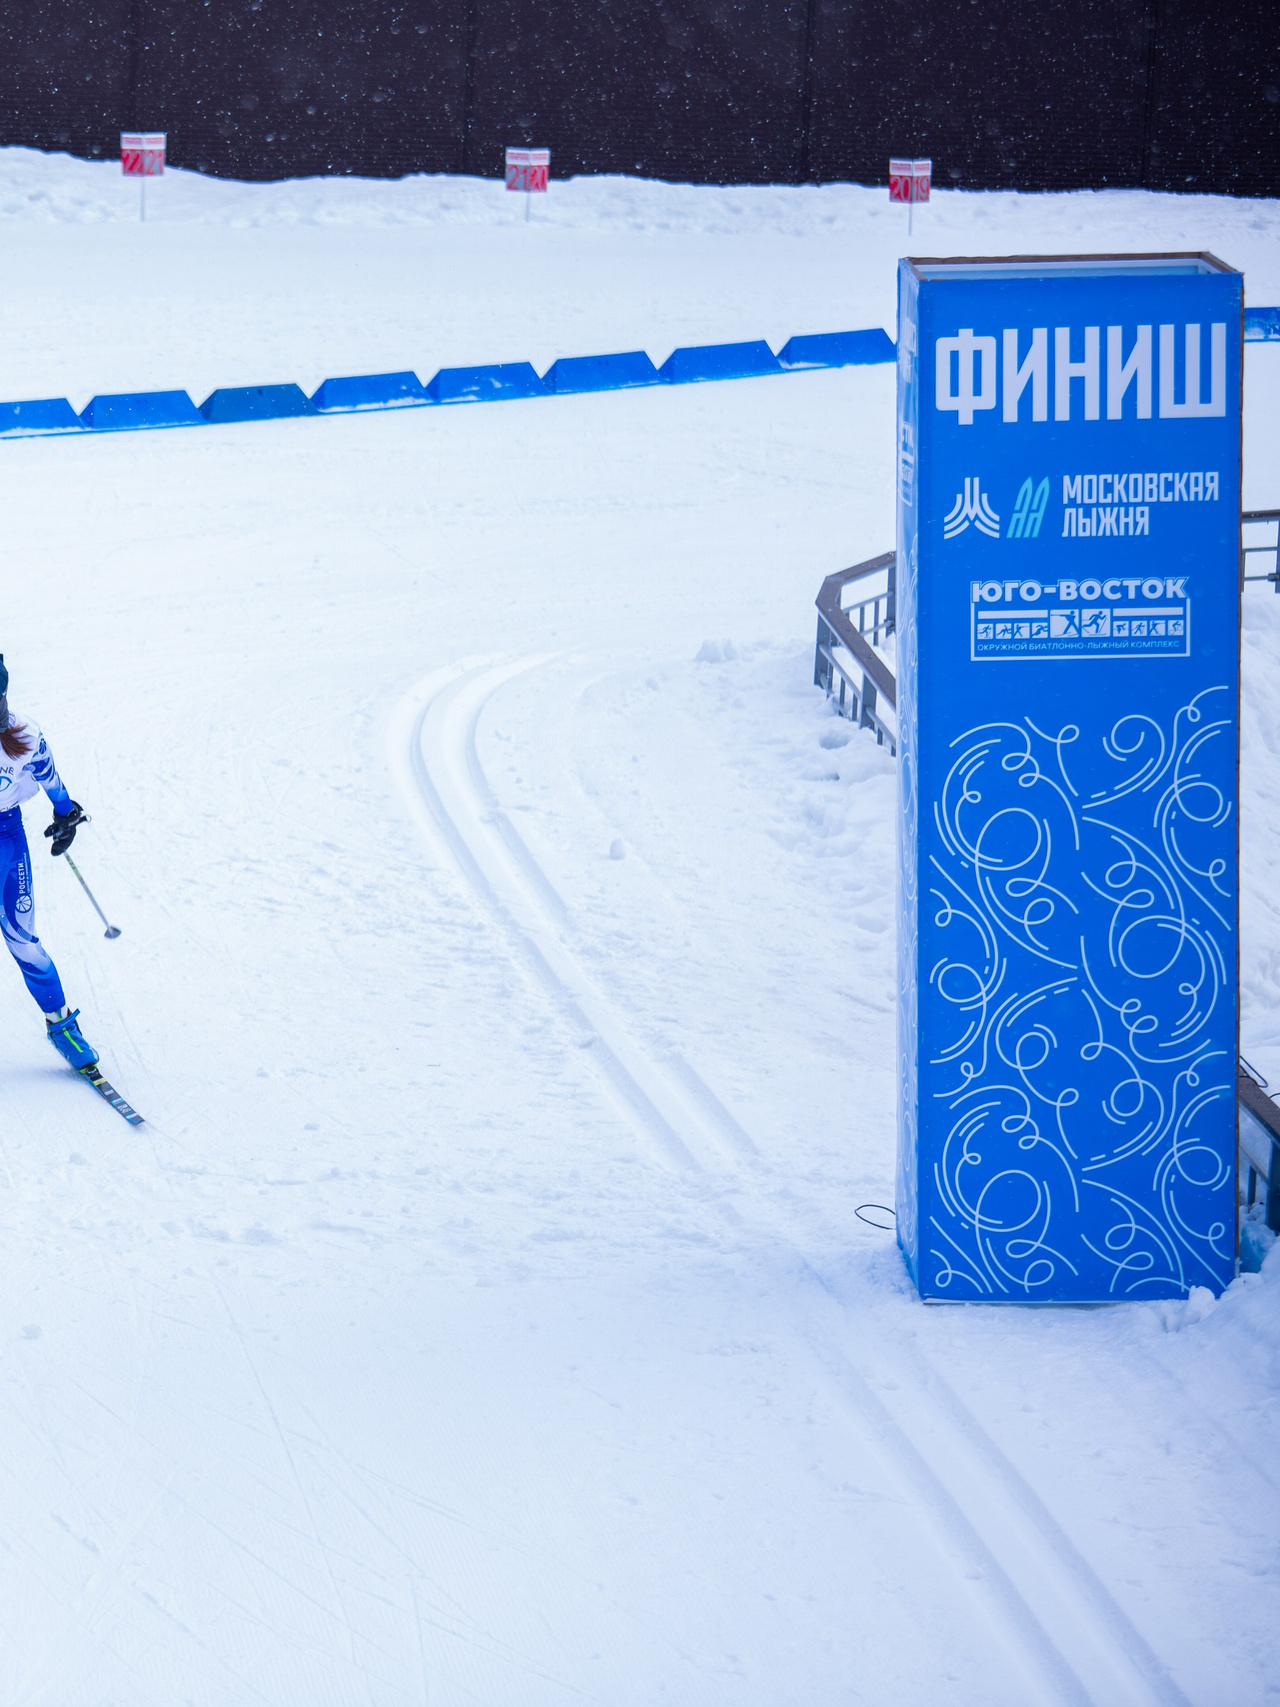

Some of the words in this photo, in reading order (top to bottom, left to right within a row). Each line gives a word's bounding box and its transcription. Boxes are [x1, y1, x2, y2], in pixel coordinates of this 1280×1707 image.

[507, 165, 528, 190] 21
[890, 175, 912, 202] 20
[913, 176, 930, 202] 19
[935, 322, 1227, 426] ФИНИШ
[1062, 471, 1219, 505] МОСКОВСКАЯ
[1061, 506, 1150, 538] ЛЫЖНЯ
[972, 578, 1187, 603] ЮГО-ВОСТОК
[977, 642, 1027, 651] ОКРУЖНОЙ
[1029, 640, 1129, 651] БИАТЛОННО-ЛЫЖНЫЙ
[1130, 640, 1180, 649] КОМПЛЕКС
[18, 862, 26, 895] РОССЕТИ
